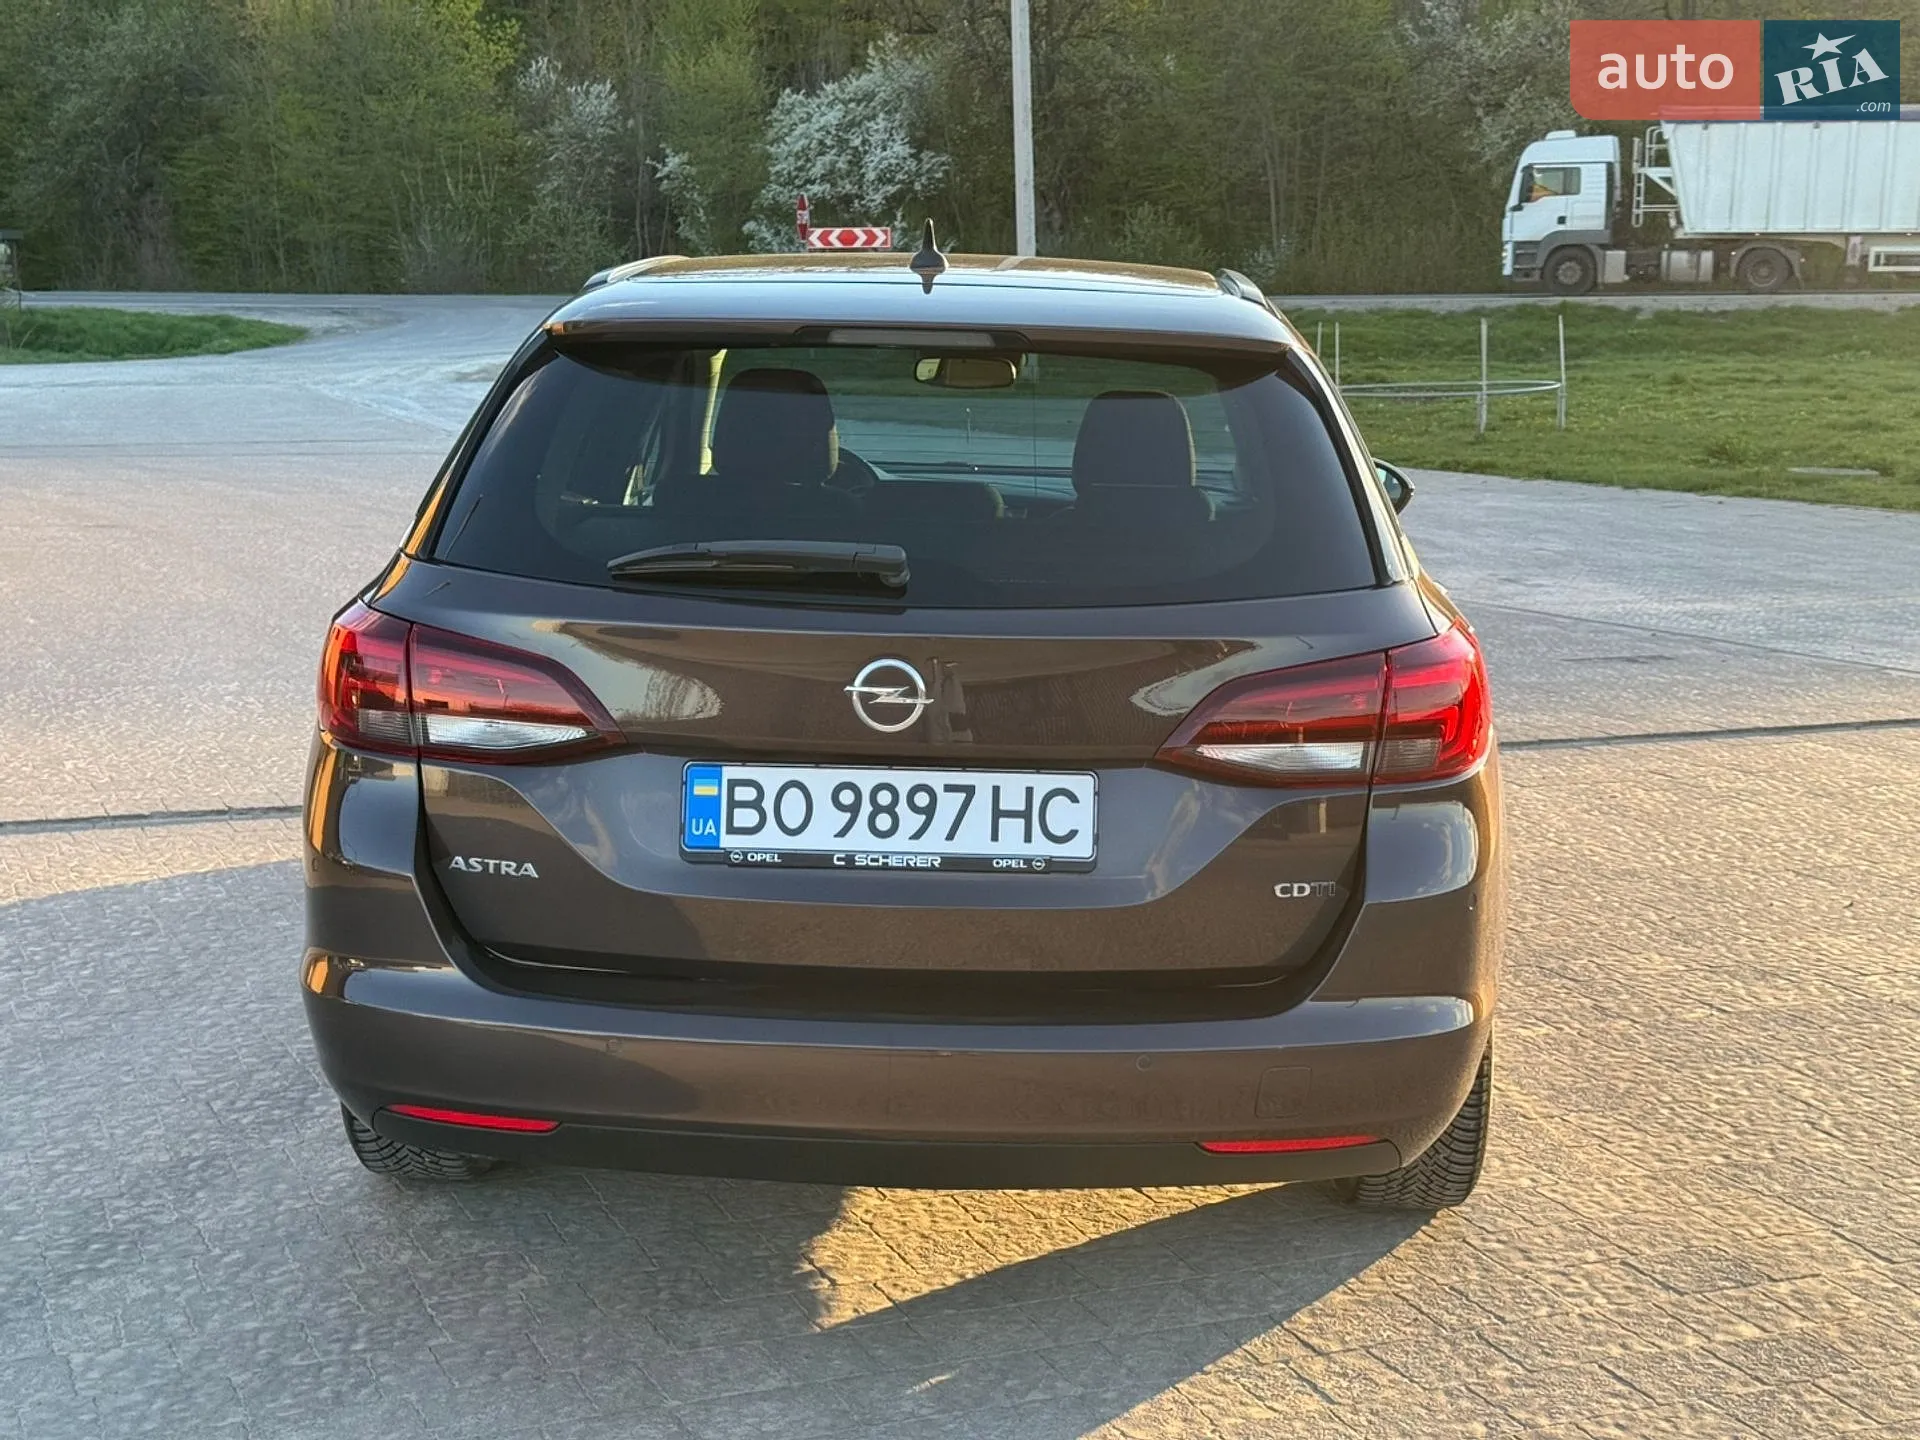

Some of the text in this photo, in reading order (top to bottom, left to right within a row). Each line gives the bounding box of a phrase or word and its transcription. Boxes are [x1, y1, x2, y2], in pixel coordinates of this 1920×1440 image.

[725, 778, 1081, 844] BO 9897 HC
[691, 818, 716, 837] UA
[747, 852, 783, 863] OPEL
[855, 854, 942, 868] SCHERER
[992, 857, 1028, 869] OPEL
[448, 856, 539, 879] ASTRA
[1273, 880, 1336, 898] CDTI
